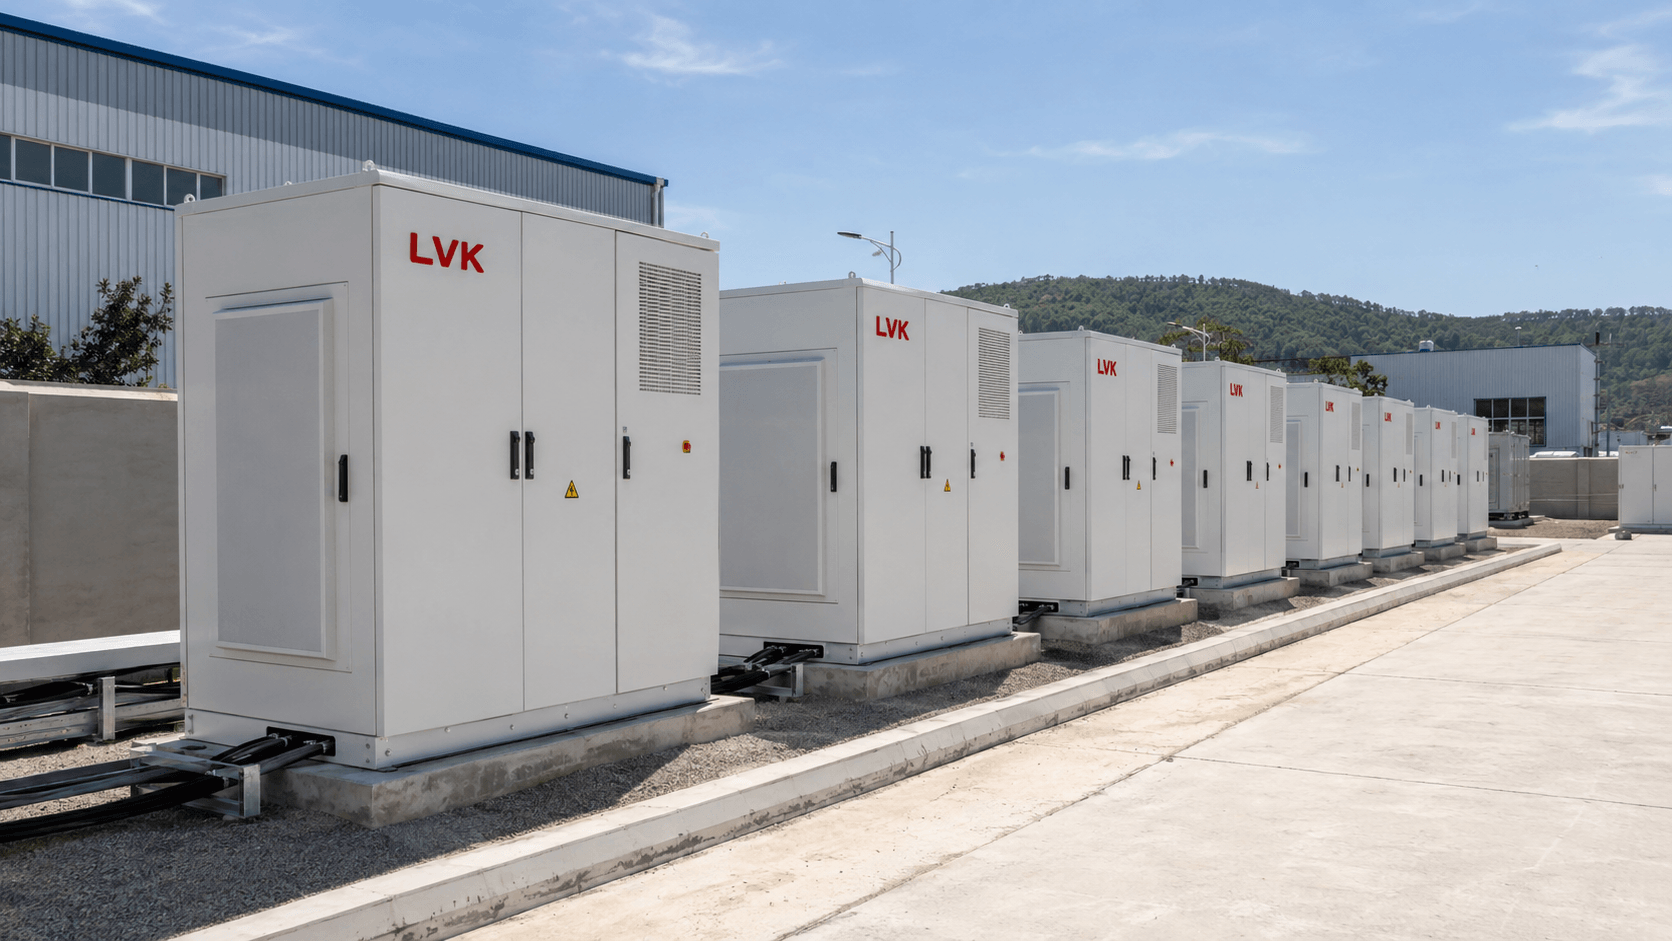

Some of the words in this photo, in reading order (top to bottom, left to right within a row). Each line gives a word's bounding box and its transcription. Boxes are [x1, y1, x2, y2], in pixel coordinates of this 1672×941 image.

[410, 232, 485, 274] LVK
[876, 315, 909, 341] LVK
[1097, 358, 1117, 377] LVK
[1229, 382, 1243, 397] LVK
